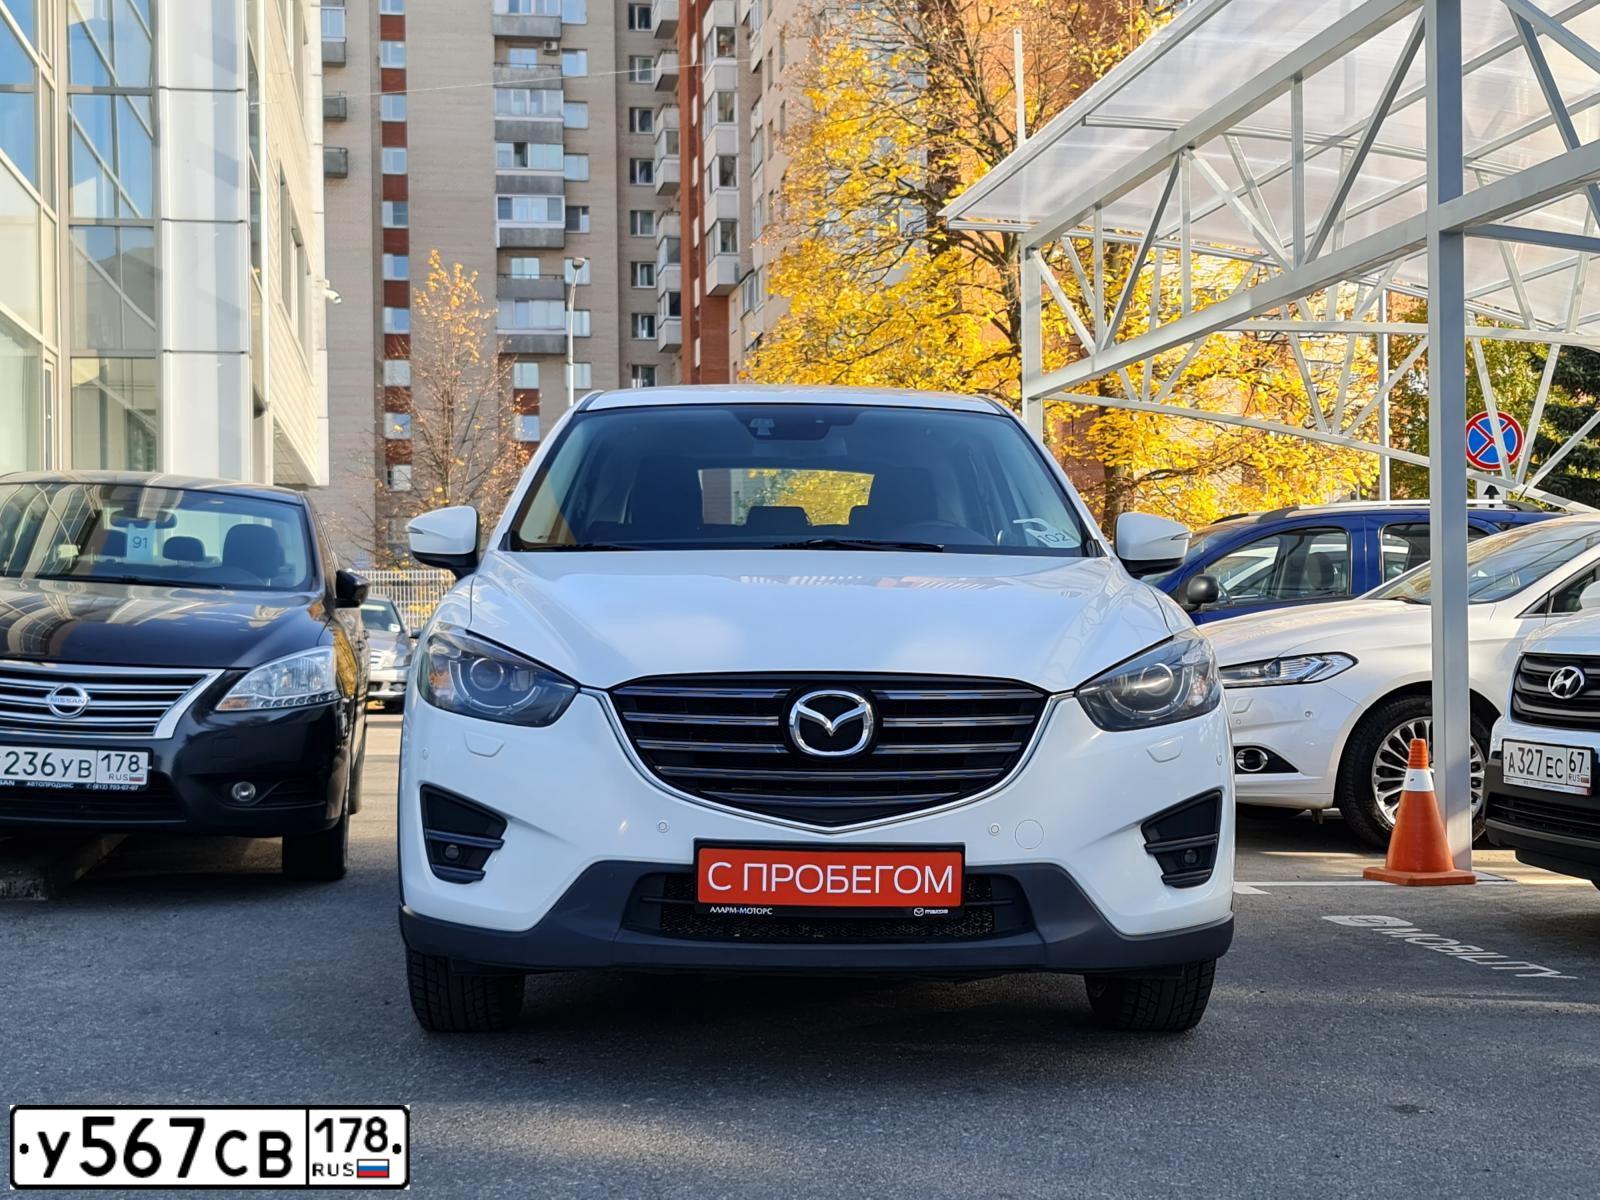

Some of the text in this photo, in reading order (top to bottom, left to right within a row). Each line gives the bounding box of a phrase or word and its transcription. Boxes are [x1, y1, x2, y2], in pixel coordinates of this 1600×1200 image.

[132, 536, 148, 549] 91
[1038, 533, 1073, 543] 102
[0, 751, 93, 778] 236УВ
[101, 753, 140, 773] 178
[1508, 747, 1564, 779] А327ЕС
[1569, 751, 1585, 774] 67
[1568, 773, 1580, 782] RUS
[707, 861, 953, 894] С ПРОБЕГОМ
